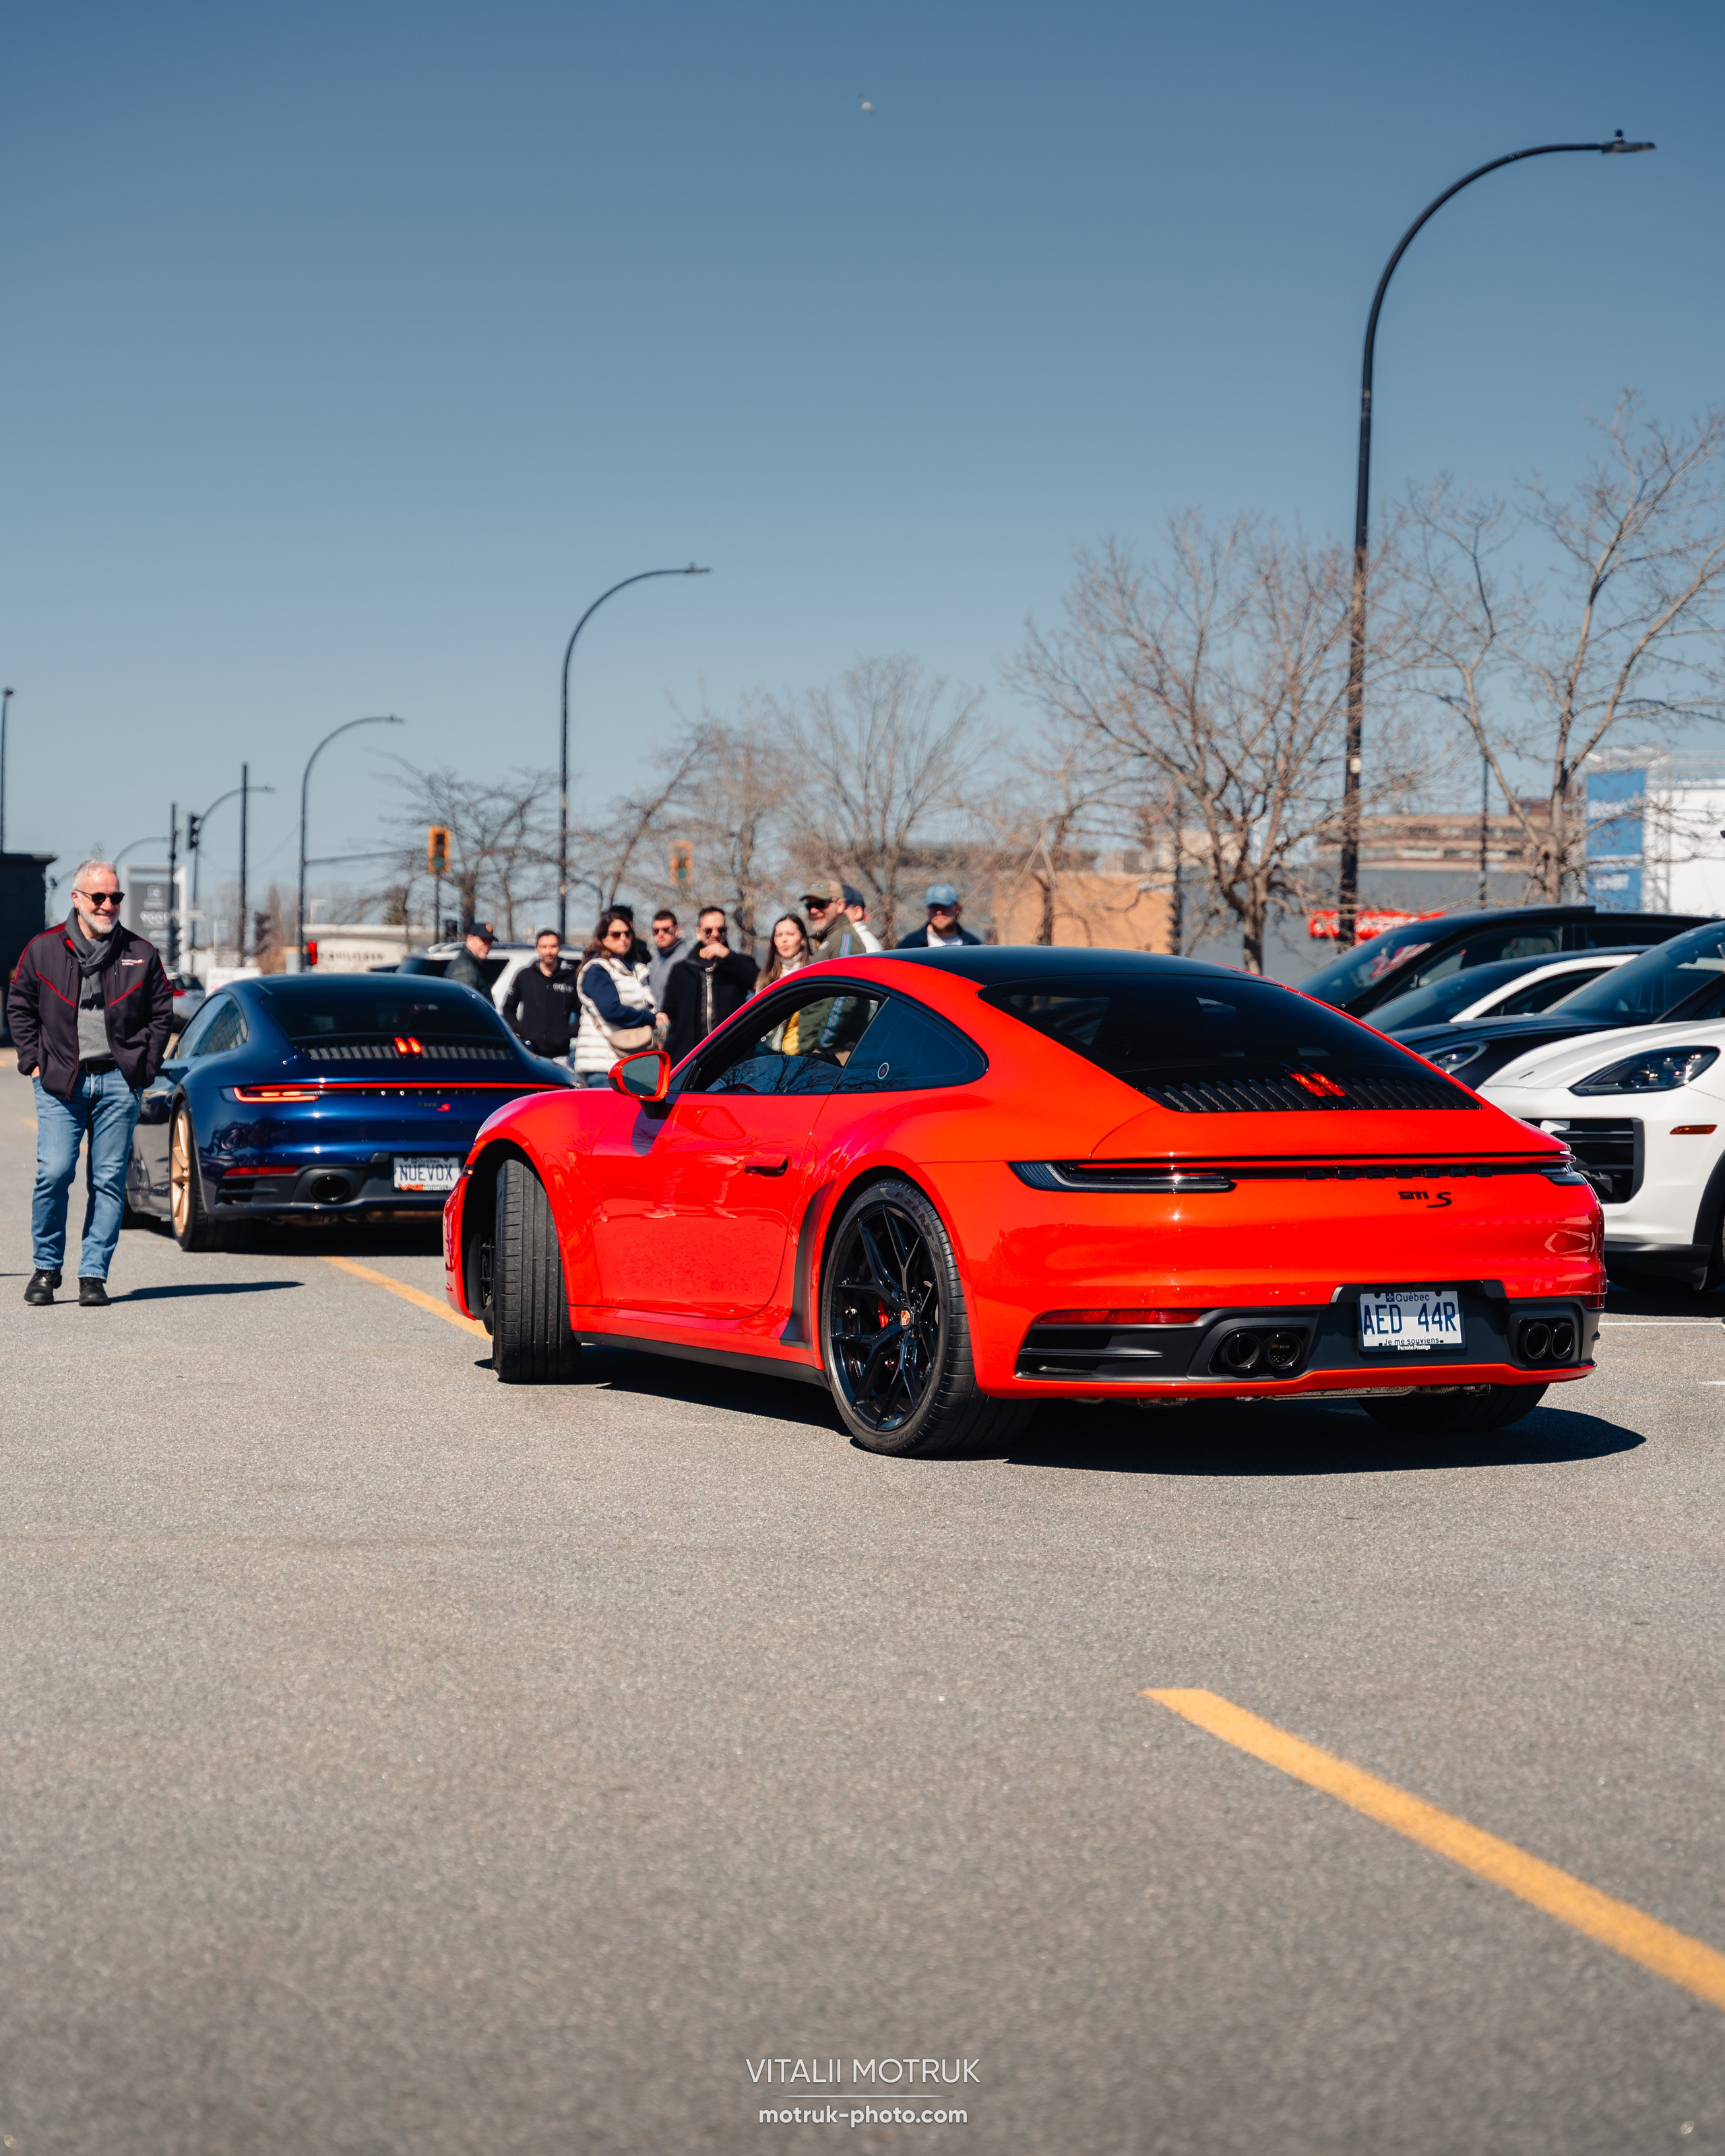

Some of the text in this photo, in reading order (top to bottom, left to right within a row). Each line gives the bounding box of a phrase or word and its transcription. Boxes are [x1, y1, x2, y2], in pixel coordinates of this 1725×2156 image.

[399, 1164, 453, 1180] NUEVOX
[1426, 1192, 1452, 1208] S
[1395, 1293, 1430, 1302] Québec
[1363, 1302, 1457, 1335] AED 44R
